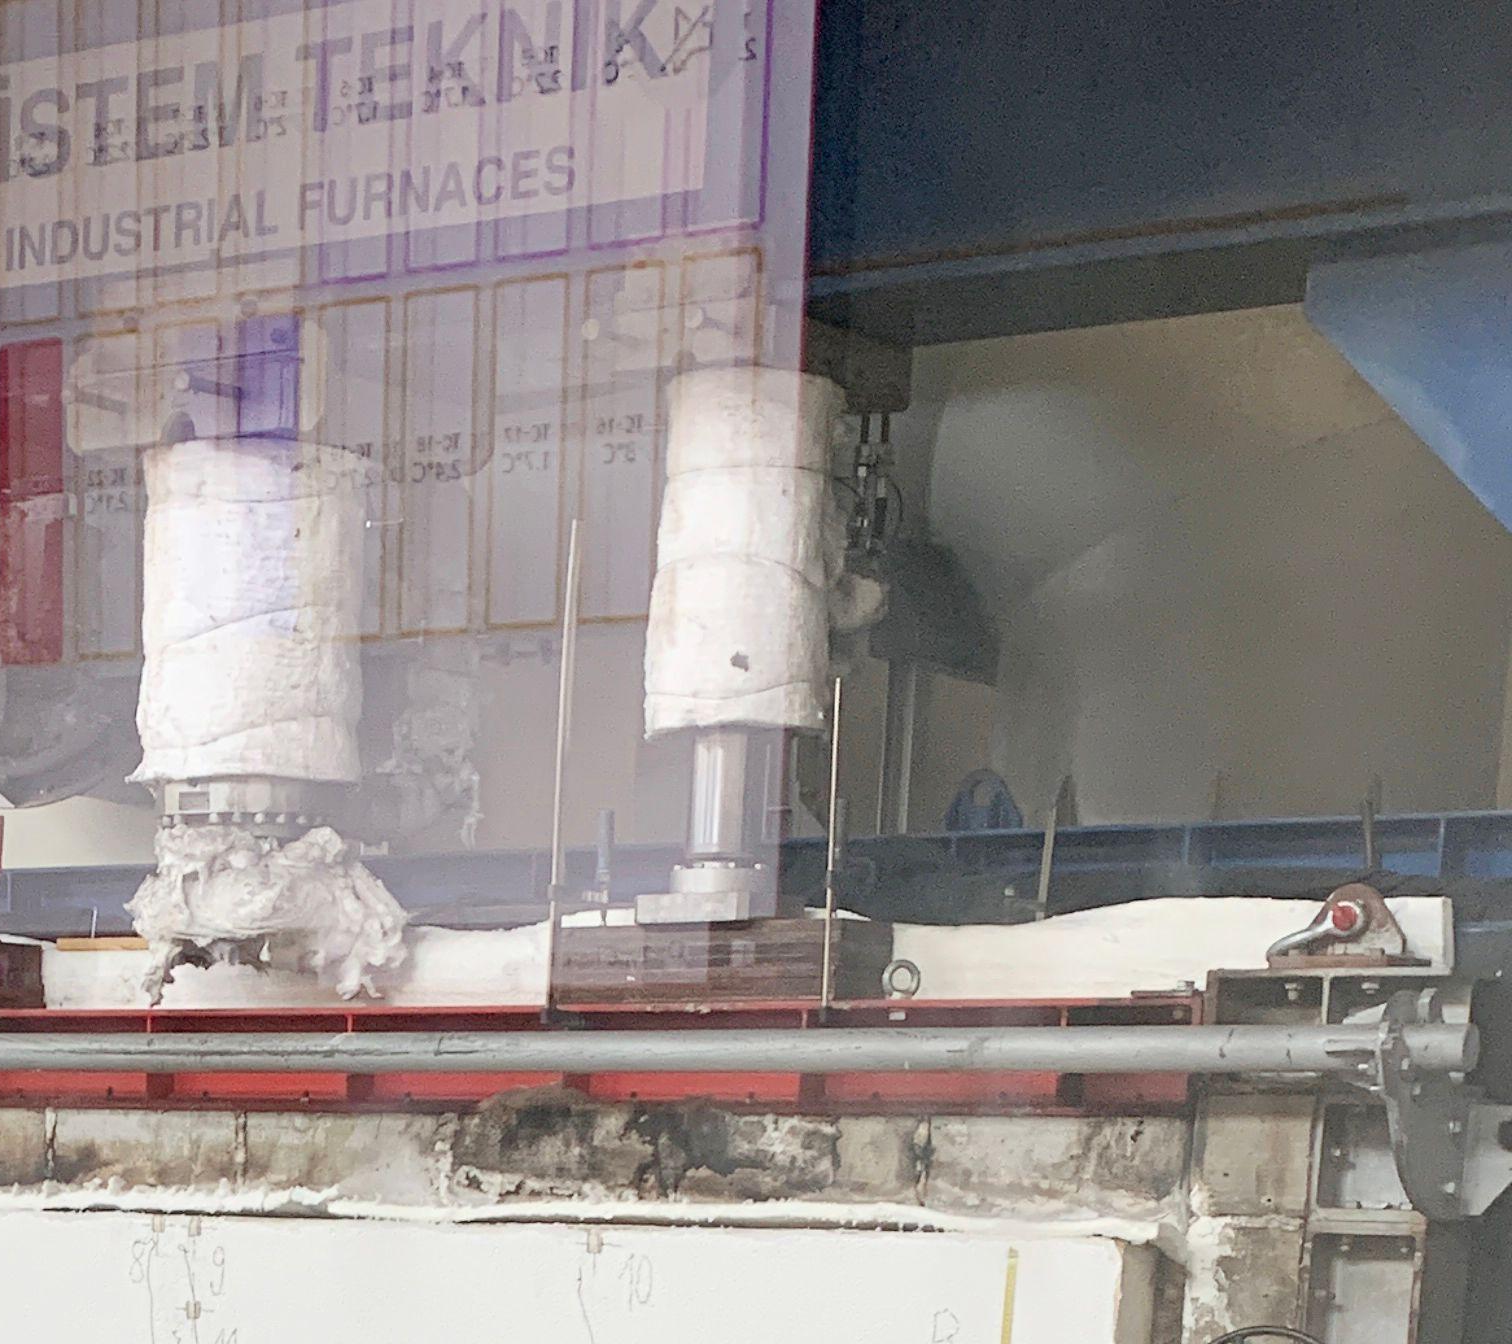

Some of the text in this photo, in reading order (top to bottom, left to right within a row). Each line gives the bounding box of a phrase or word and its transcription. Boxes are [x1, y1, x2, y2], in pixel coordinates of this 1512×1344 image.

[4, 146, 576, 272] INDUSTRIAL FURNACES
[129, 1239, 146, 1285] 8
